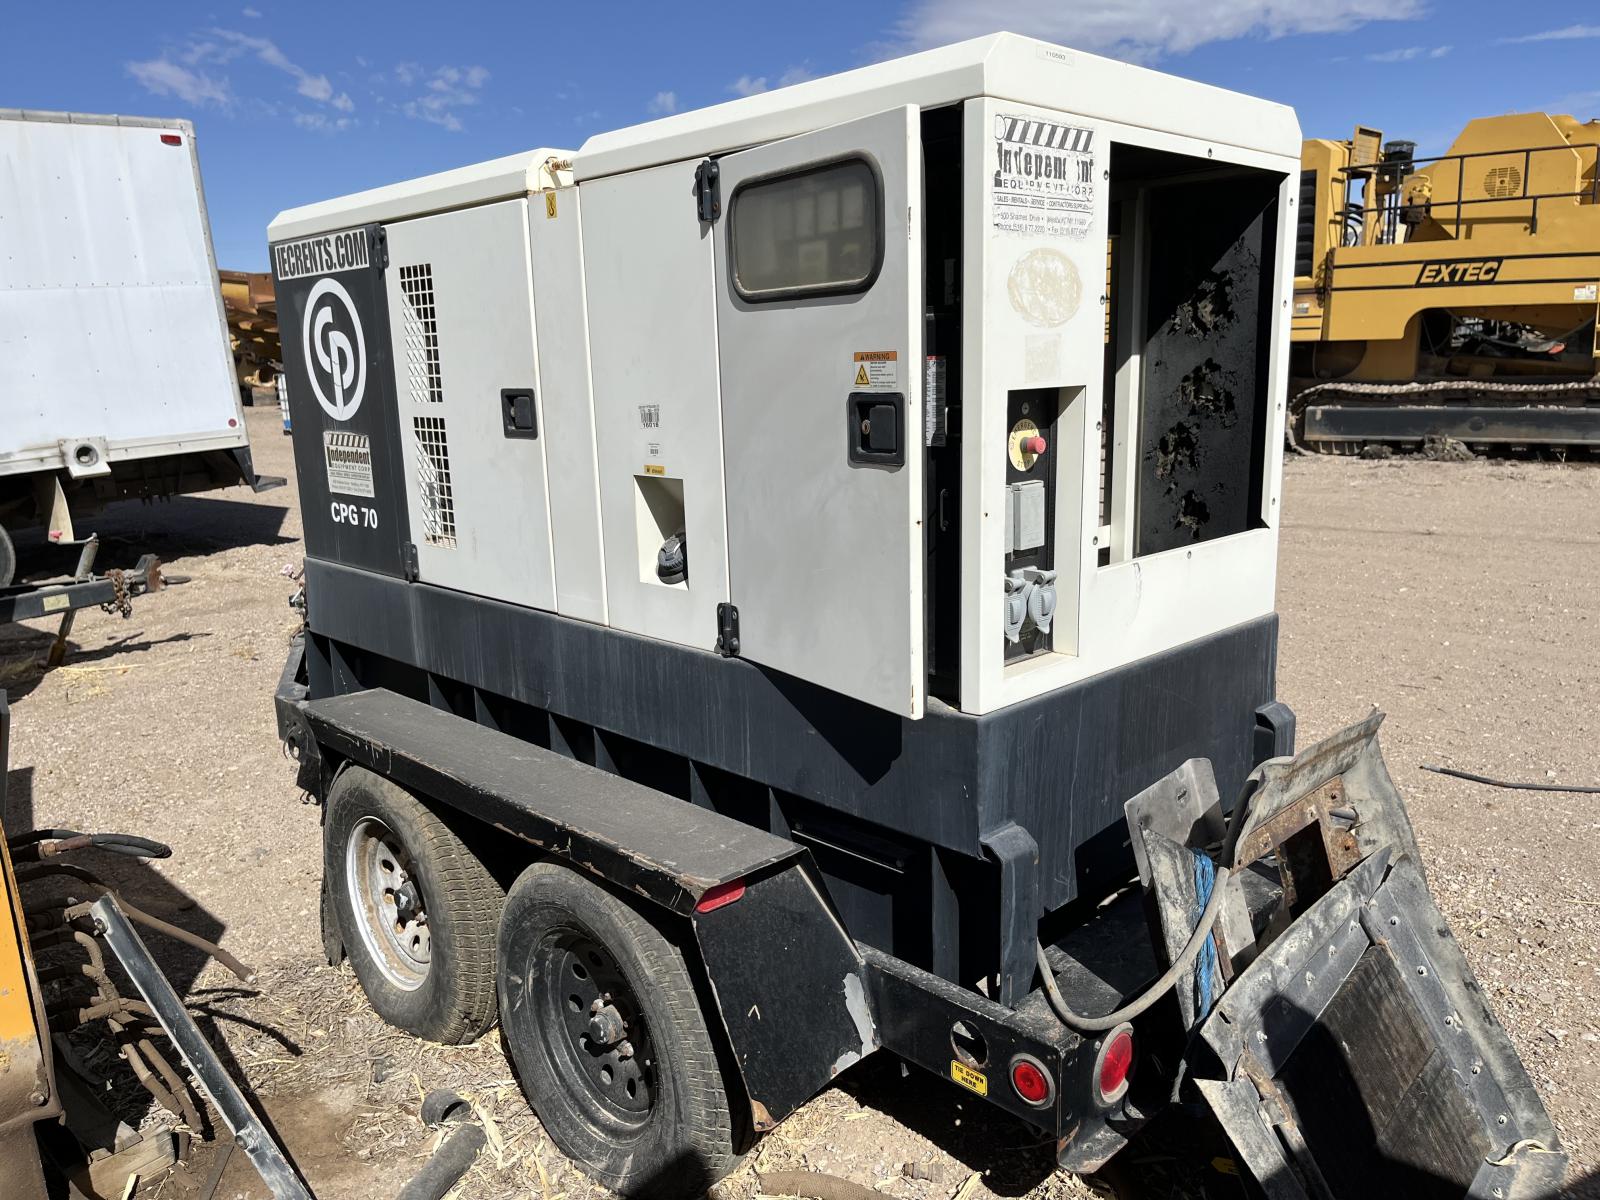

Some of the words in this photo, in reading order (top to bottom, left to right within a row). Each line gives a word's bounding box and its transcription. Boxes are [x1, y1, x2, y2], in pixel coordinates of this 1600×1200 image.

[277, 231, 367, 278] IECRENTS.COM
[1420, 261, 1498, 284] EXTEC
[865, 352, 890, 360] WARNING
[326, 446, 371, 468] Independent
[331, 502, 358, 526] CPG
[361, 507, 378, 529] 70
[955, 1065, 963, 1073] TIE
[966, 1071, 984, 1084] DOWN
[961, 1076, 977, 1087] HERE
